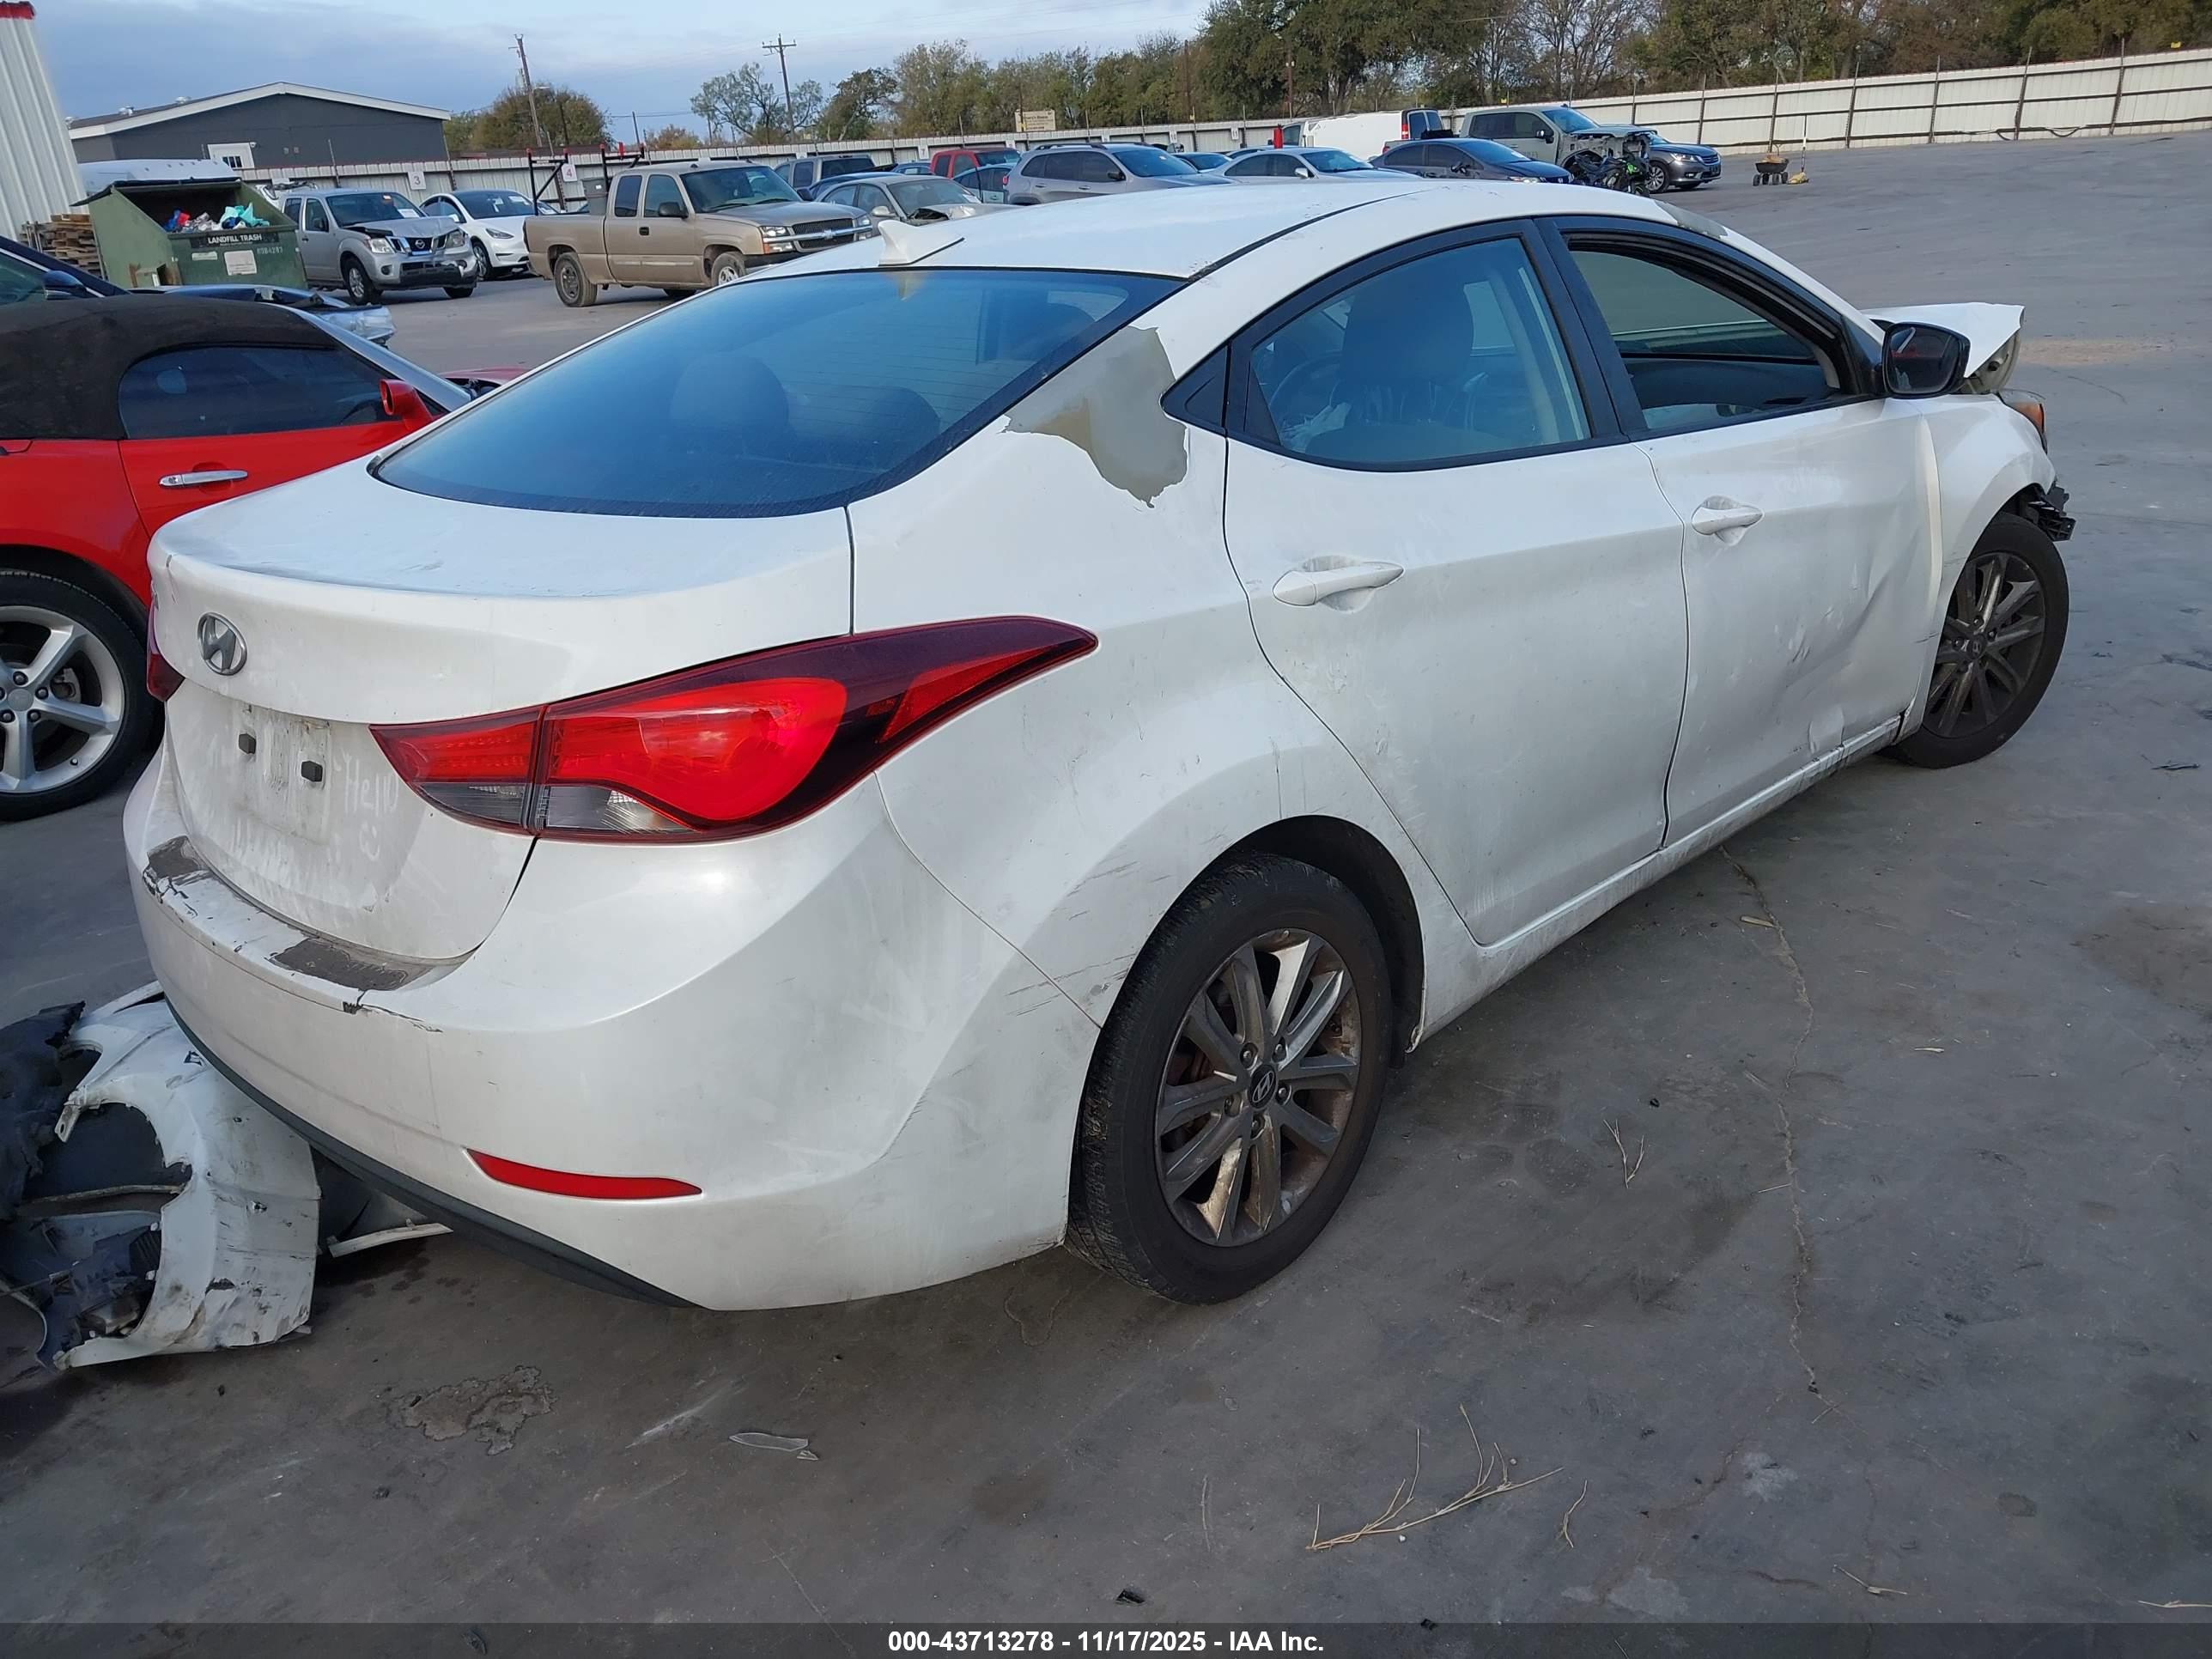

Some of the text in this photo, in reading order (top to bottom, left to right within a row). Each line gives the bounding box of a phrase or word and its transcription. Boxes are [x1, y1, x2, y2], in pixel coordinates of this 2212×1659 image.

[567, 168, 572, 177] 4
[413, 175, 421, 185] 3
[208, 235, 239, 244] LANDFILL
